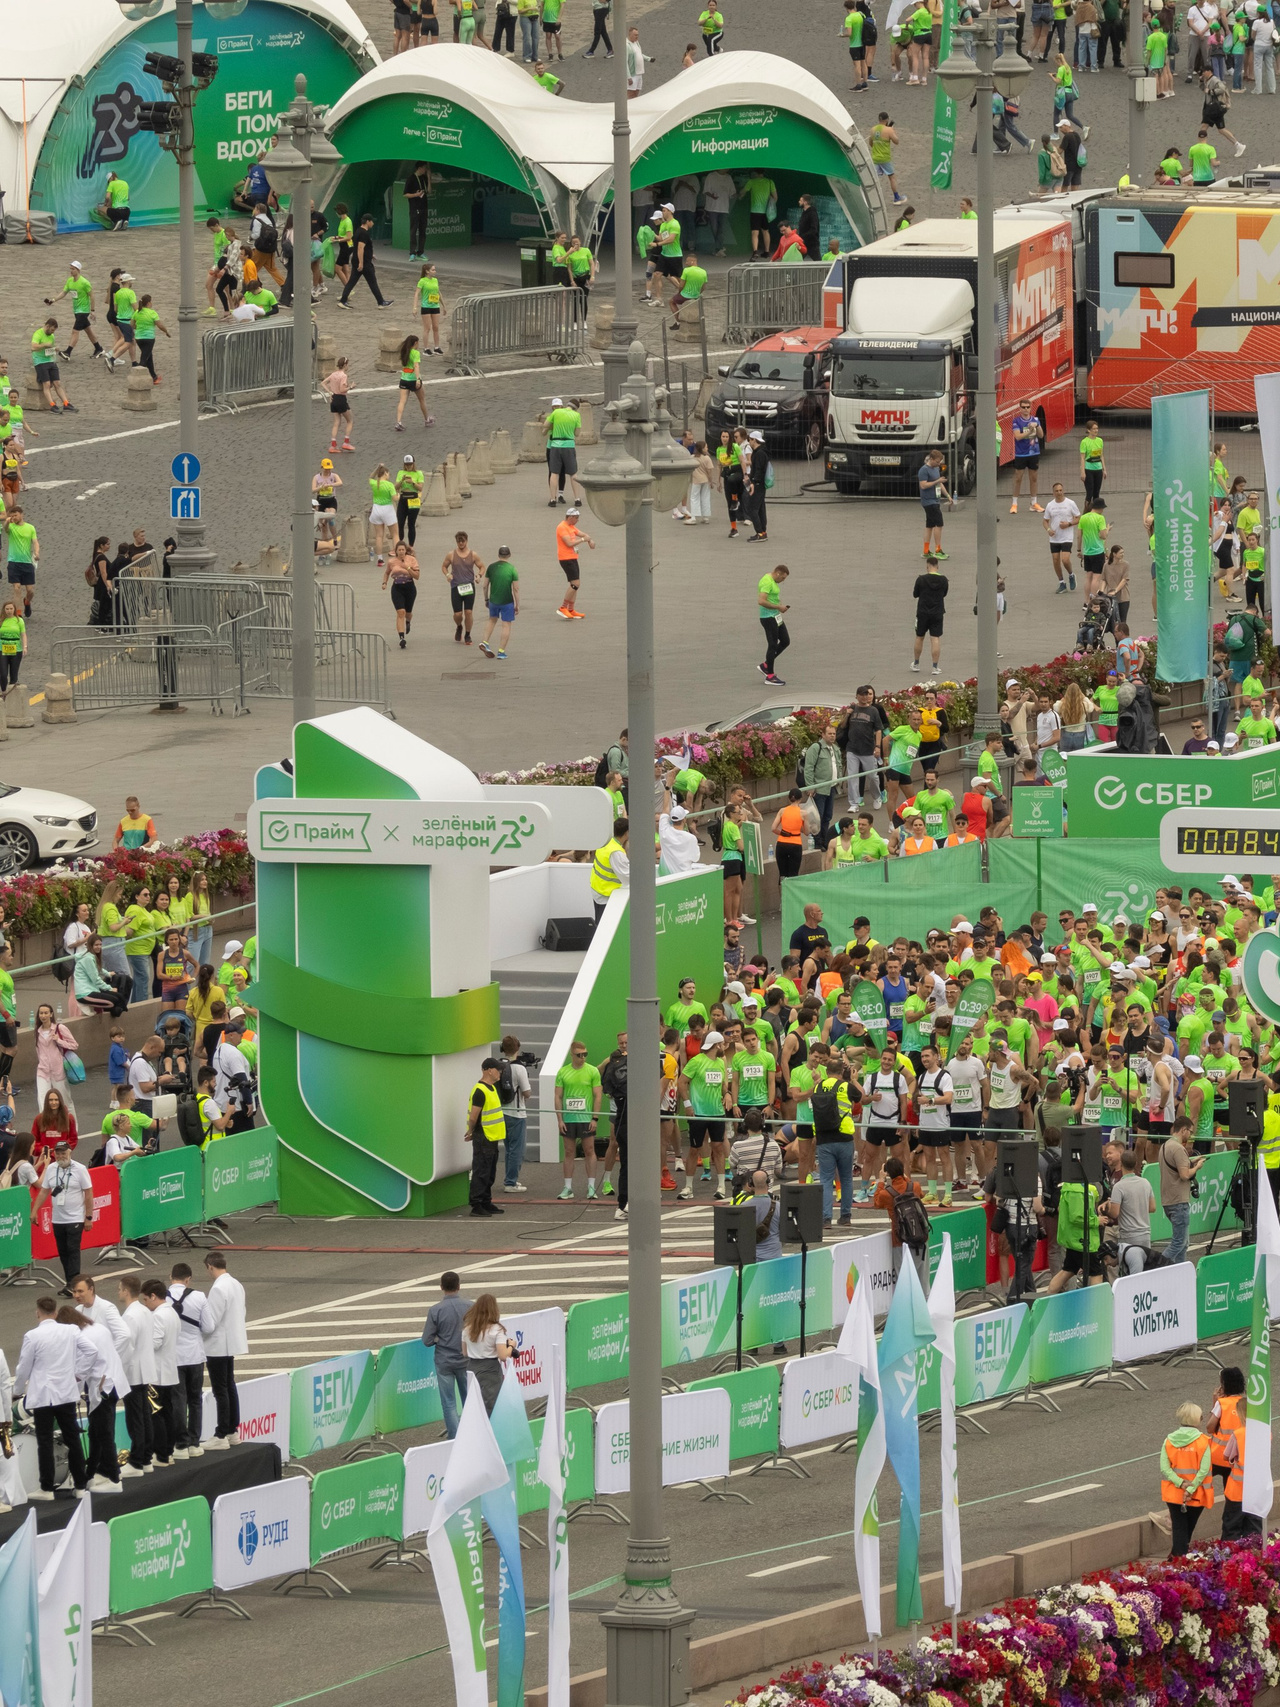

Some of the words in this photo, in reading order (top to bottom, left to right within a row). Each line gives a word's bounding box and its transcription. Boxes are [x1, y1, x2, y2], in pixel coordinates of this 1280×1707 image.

[228, 39, 249, 49] Прайм
[265, 38, 292, 48] марафон
[269, 33, 293, 43] зелёный
[225, 89, 273, 111] БЕГИ
[416, 100, 442, 110] зелёный
[413, 106, 440, 118] марафон
[738, 108, 766, 120] зелёный
[694, 116, 717, 128] Прайм
[735, 115, 763, 128] марафон
[403, 126, 421, 139] Легче
[436, 131, 458, 143] Прайм
[691, 137, 769, 155] Информация
[1097, 307, 1178, 334] МАТЧ!
[858, 340, 918, 350] ТЕЛЕВИДЕНИЕ
[861, 409, 911, 425] МАТЧ!
[866, 424, 905, 434] IVECO
[1165, 517, 1180, 593] зелёный
[1179, 521, 1197, 602] марафон
[1135, 782, 1213, 806] СБЕР
[294, 821, 355, 843] Прайм
[422, 814, 497, 832] зелёный
[412, 831, 490, 851] марафон
[677, 895, 699, 912] зелёный
[675, 910, 697, 926] марафон
[959, 1000, 982, 1014] 0:39
[745, 1066, 761, 1074] 9133
[955, 1088, 970, 1098] 7717
[248, 1155, 266, 1172] зелёный
[221, 1166, 240, 1186] СБЕР
[246, 1168, 265, 1182] марафон
[142, 1188, 156, 1200] Легче
[166, 1179, 182, 1195] Прайм
[953, 1236, 971, 1251] зелёный
[678, 1279, 718, 1327] БЕГИ
[1132, 1290, 1159, 1315] ЭКО-
[1212, 1290, 1226, 1304] Прайм
[1236, 1289, 1254, 1304] марафон
[591, 1313, 624, 1340] зелёный
[679, 1320, 715, 1342] НАСТОЯЩИМ
[1133, 1308, 1180, 1338] КУЛЬТУРА
[974, 1316, 1013, 1362] БЕГИ
[587, 1337, 620, 1363] марафон
[974, 1356, 1009, 1377] НАСТОЯЩИМ
[313, 1366, 354, 1415] БЕГИ
[812, 1388, 835, 1411] СБЕР
[835, 1383, 853, 1406] KIDS
[741, 1395, 763, 1414] зелёный
[737, 1411, 761, 1429] марафон
[611, 1432, 630, 1447] СБЕ
[682, 1433, 720, 1454] ЖИЗНИ
[368, 1483, 391, 1500] зелёный
[333, 1496, 356, 1521] СБЕР
[364, 1496, 388, 1514] марафон
[134, 1523, 173, 1556] зелёный
[262, 1518, 290, 1550] РУДН
[131, 1549, 171, 1583] марафон
